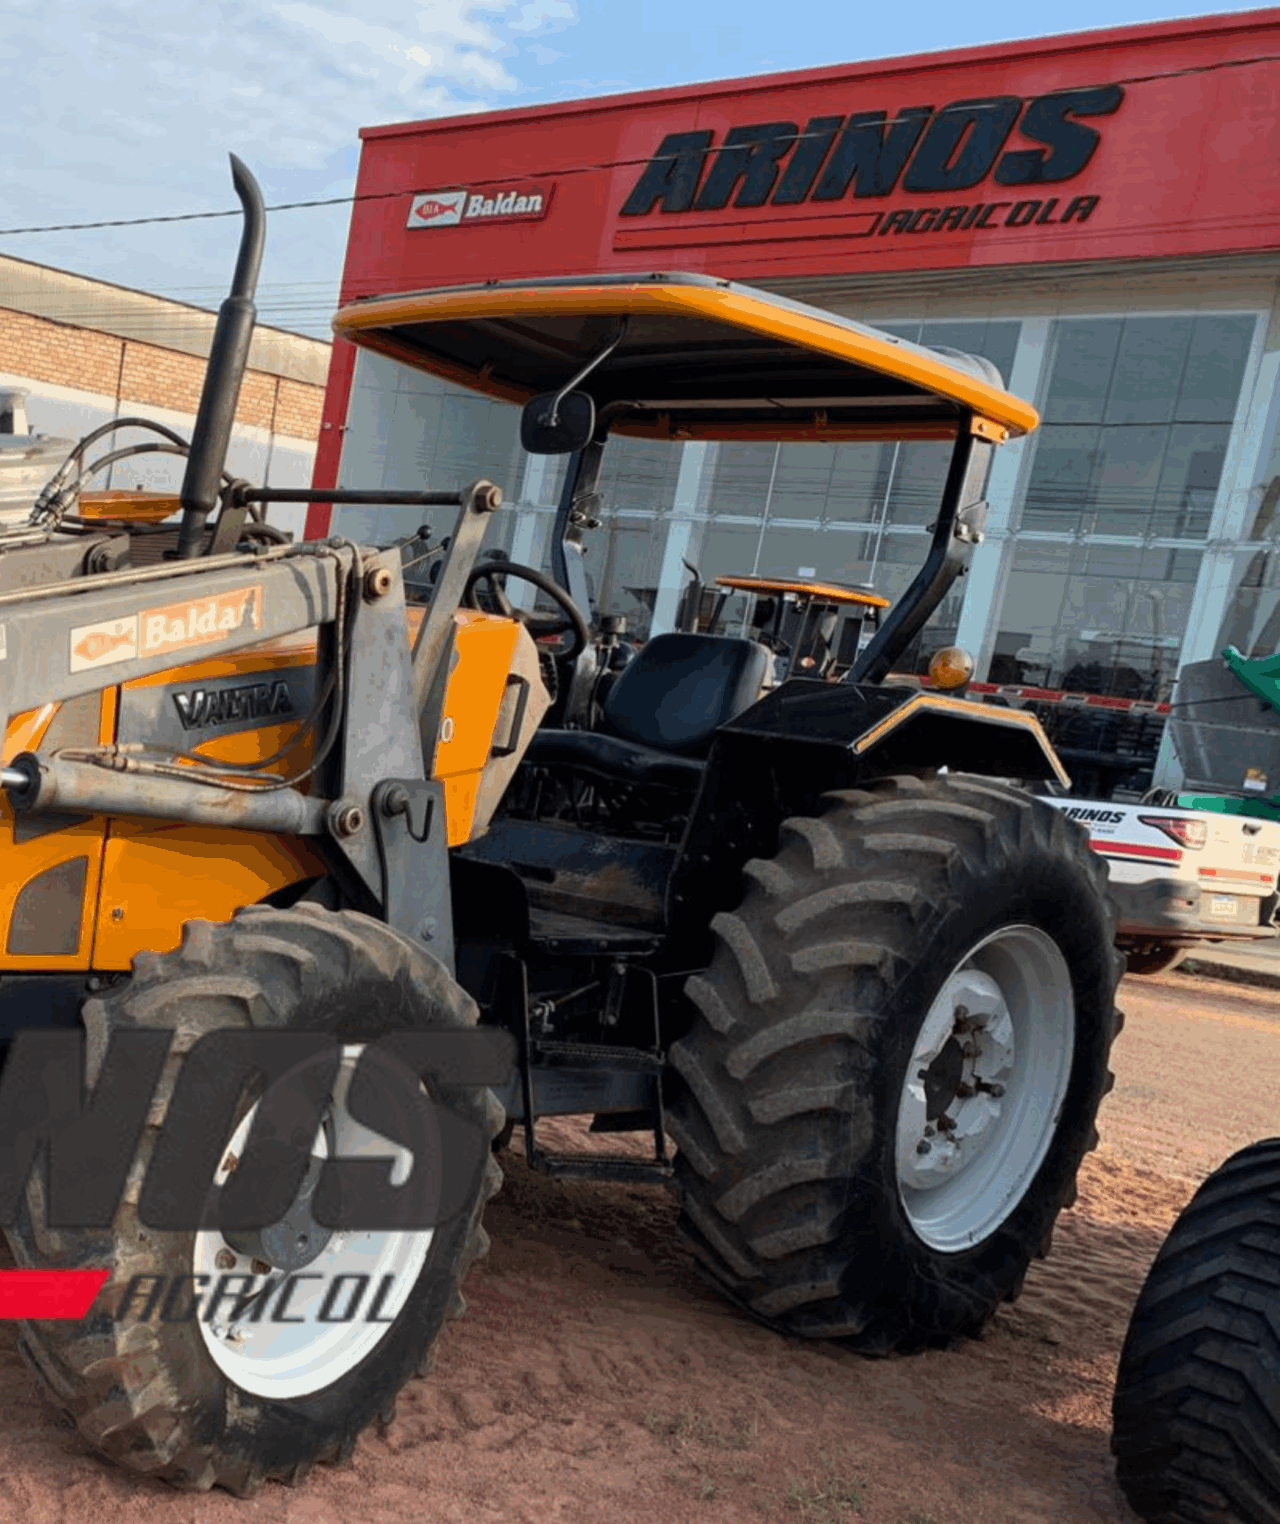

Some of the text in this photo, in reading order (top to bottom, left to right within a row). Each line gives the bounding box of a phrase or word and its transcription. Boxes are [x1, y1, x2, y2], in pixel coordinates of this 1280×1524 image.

[618, 83, 1125, 216] ARINOS
[464, 191, 543, 218] Baldan
[878, 195, 1102, 236] AGRICOLA
[172, 680, 296, 731] VALTRA
